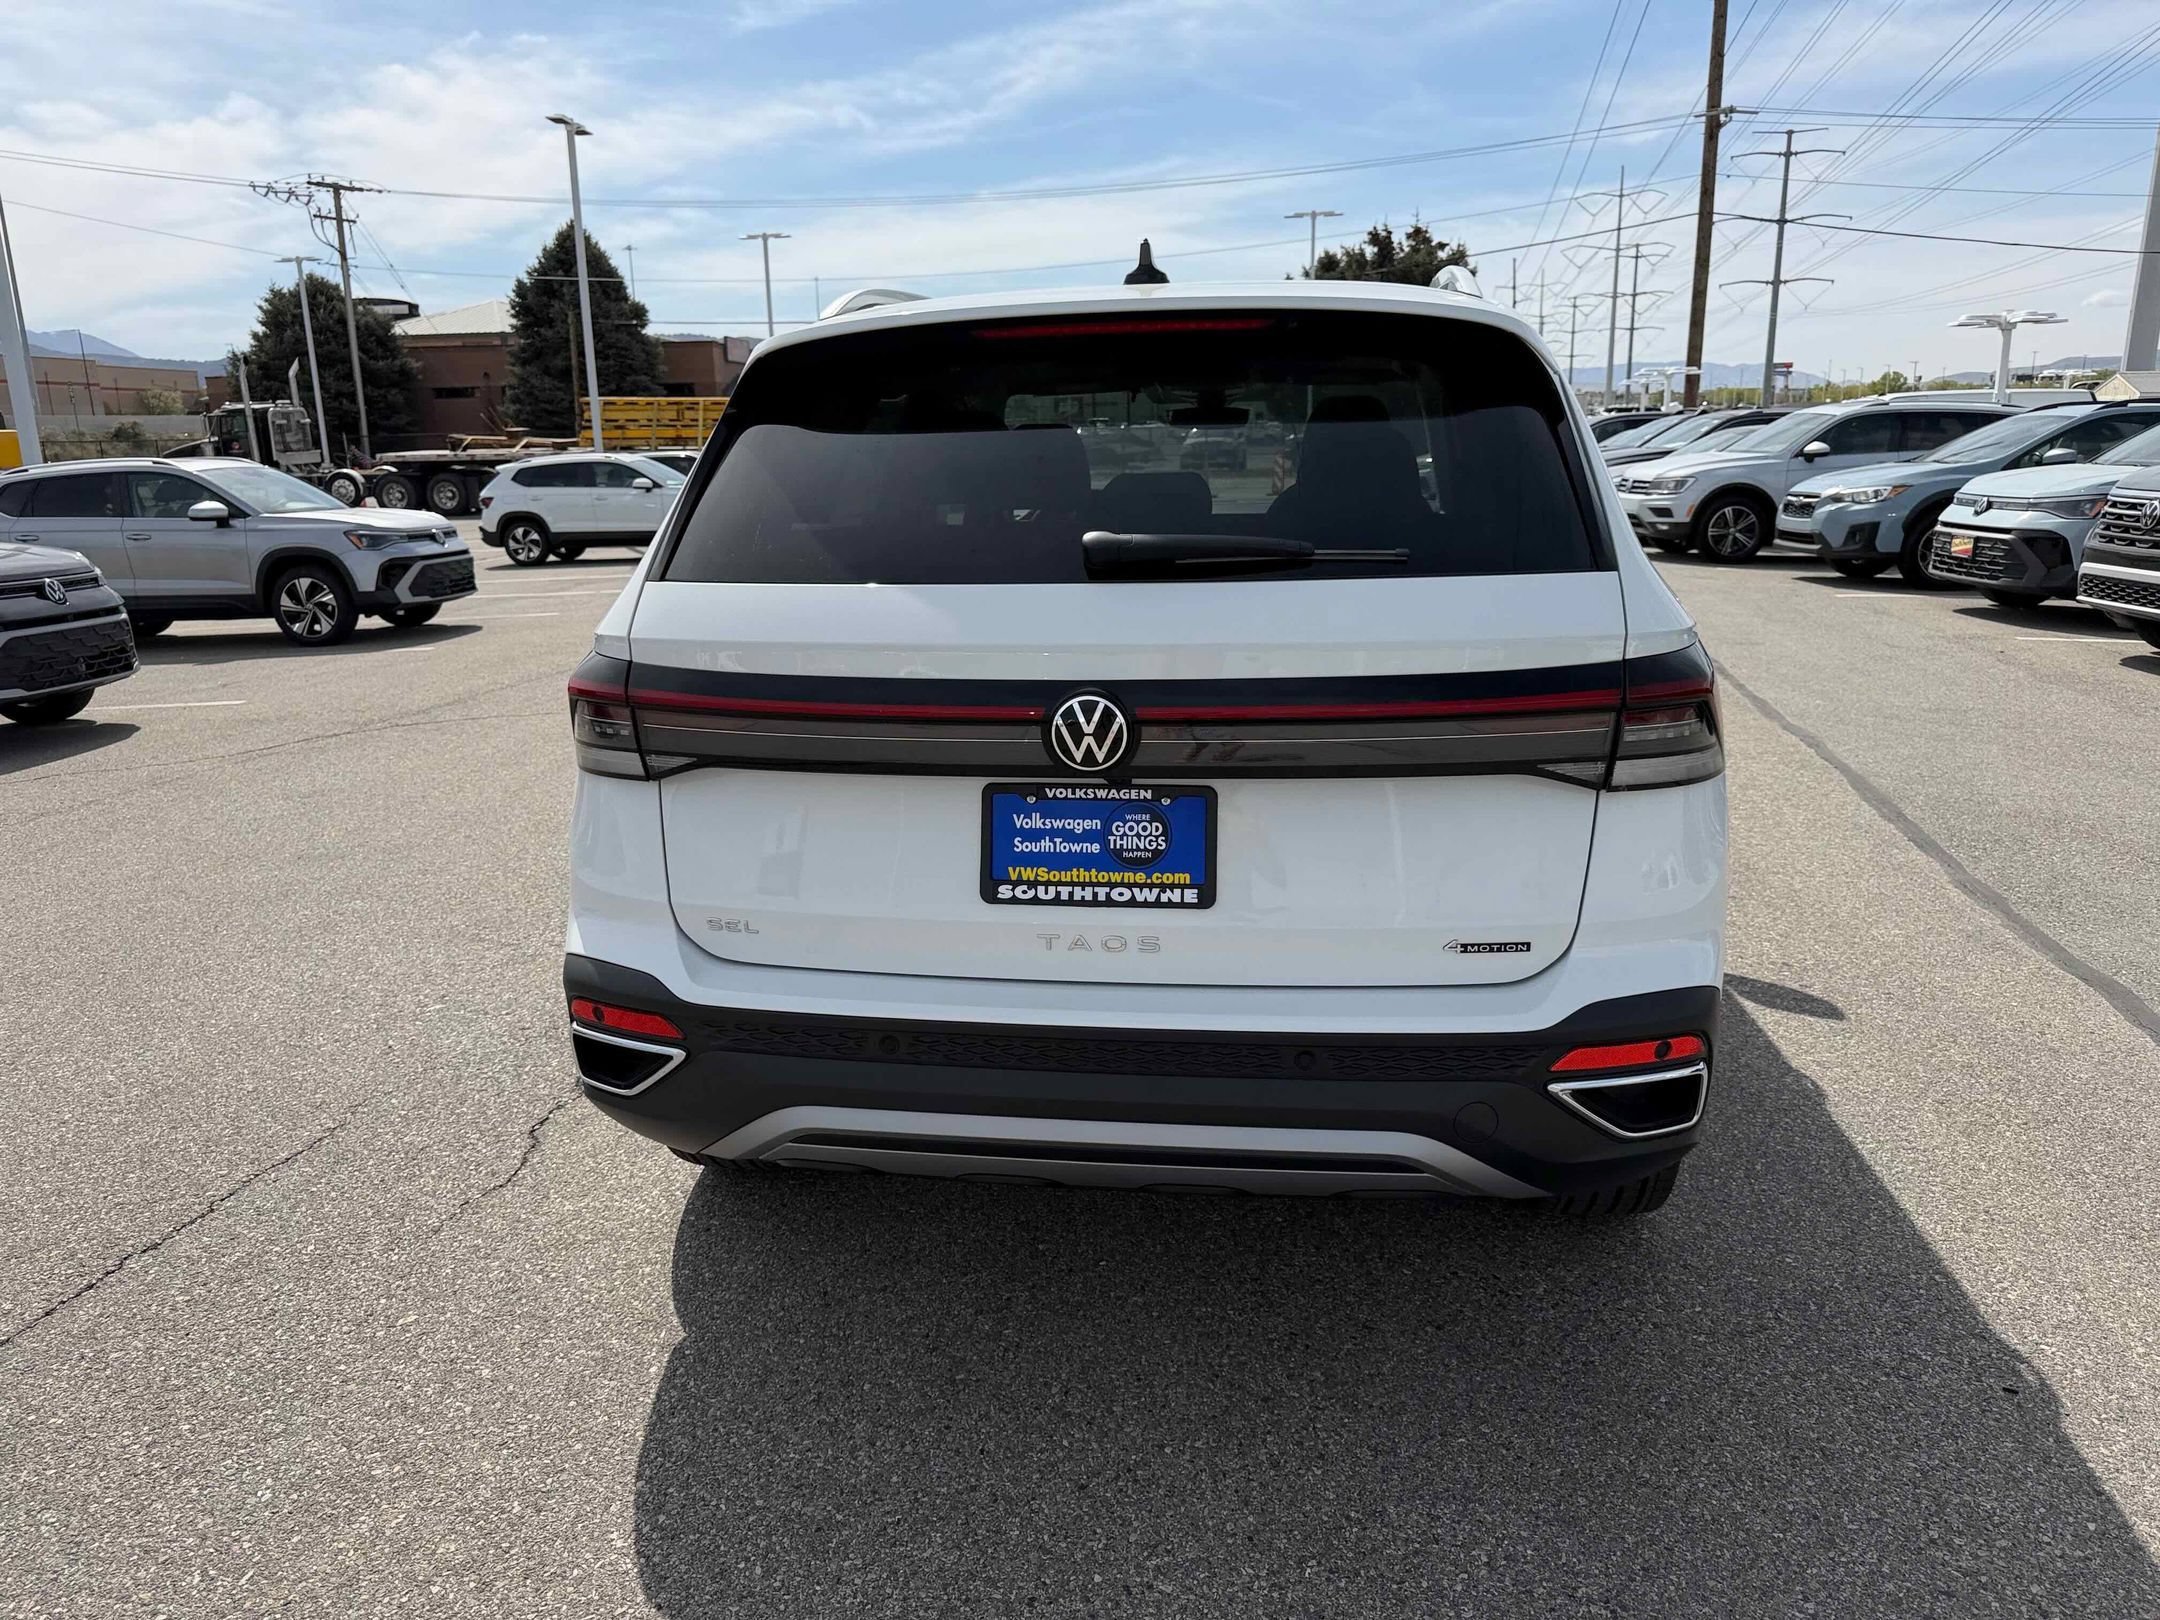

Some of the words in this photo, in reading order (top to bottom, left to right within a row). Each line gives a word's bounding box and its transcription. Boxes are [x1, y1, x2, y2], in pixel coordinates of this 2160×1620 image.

[46, 580, 65, 603] VW
[1054, 698, 1125, 767] VW
[1045, 787, 1152, 800] VOLKSWAGEN
[1013, 812, 1101, 833] Volkswagen
[1111, 821, 1163, 836] GOOD
[1013, 837, 1100, 854] SouthTowne
[1108, 835, 1166, 850] THINGS
[1007, 866, 1191, 884] VWSouthtowne.com
[996, 884, 1199, 903] SOUTHTOWNE
[706, 916, 760, 935] SEL
[1036, 933, 1161, 954] TAOS
